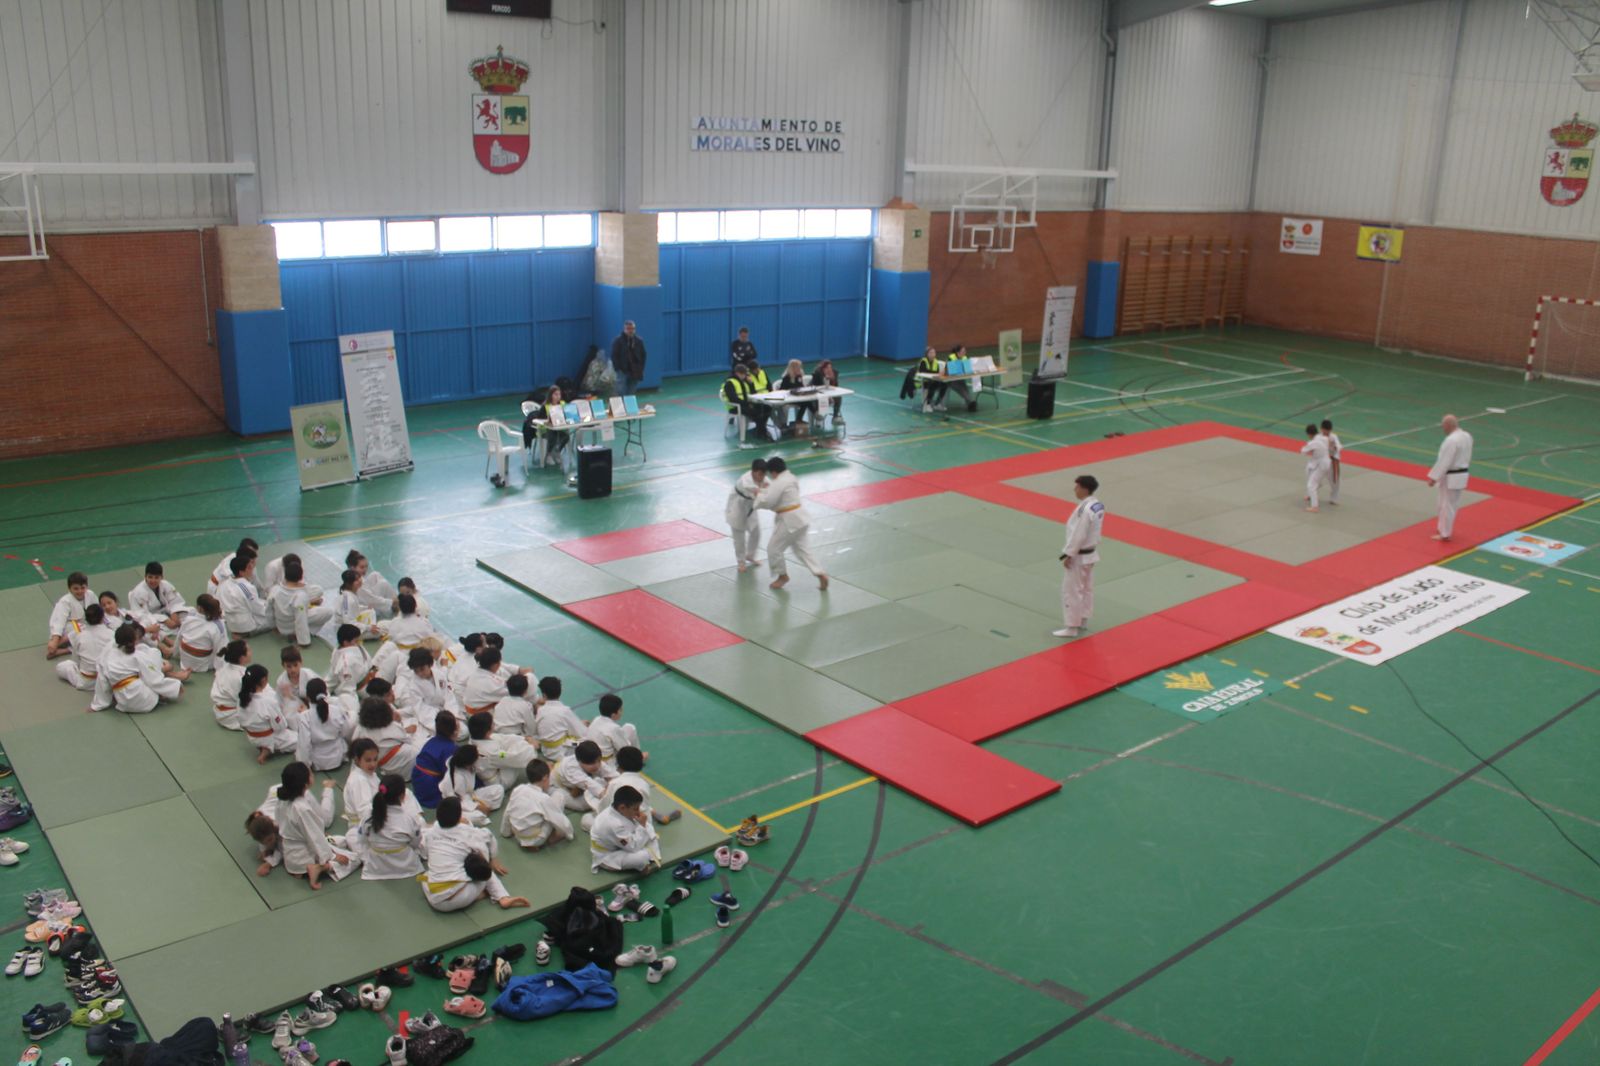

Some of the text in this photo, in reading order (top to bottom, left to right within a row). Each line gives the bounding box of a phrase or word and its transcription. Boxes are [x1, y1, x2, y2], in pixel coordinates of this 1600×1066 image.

[697, 116, 842, 133] AYUNTAMIENTO DE
[696, 135, 841, 152] MORALES DEL VINO
[1339, 577, 1444, 619] Club de Judo
[1358, 624, 1384, 636] de
[1373, 600, 1439, 626] Morales
[1448, 579, 1486, 594] Vino
